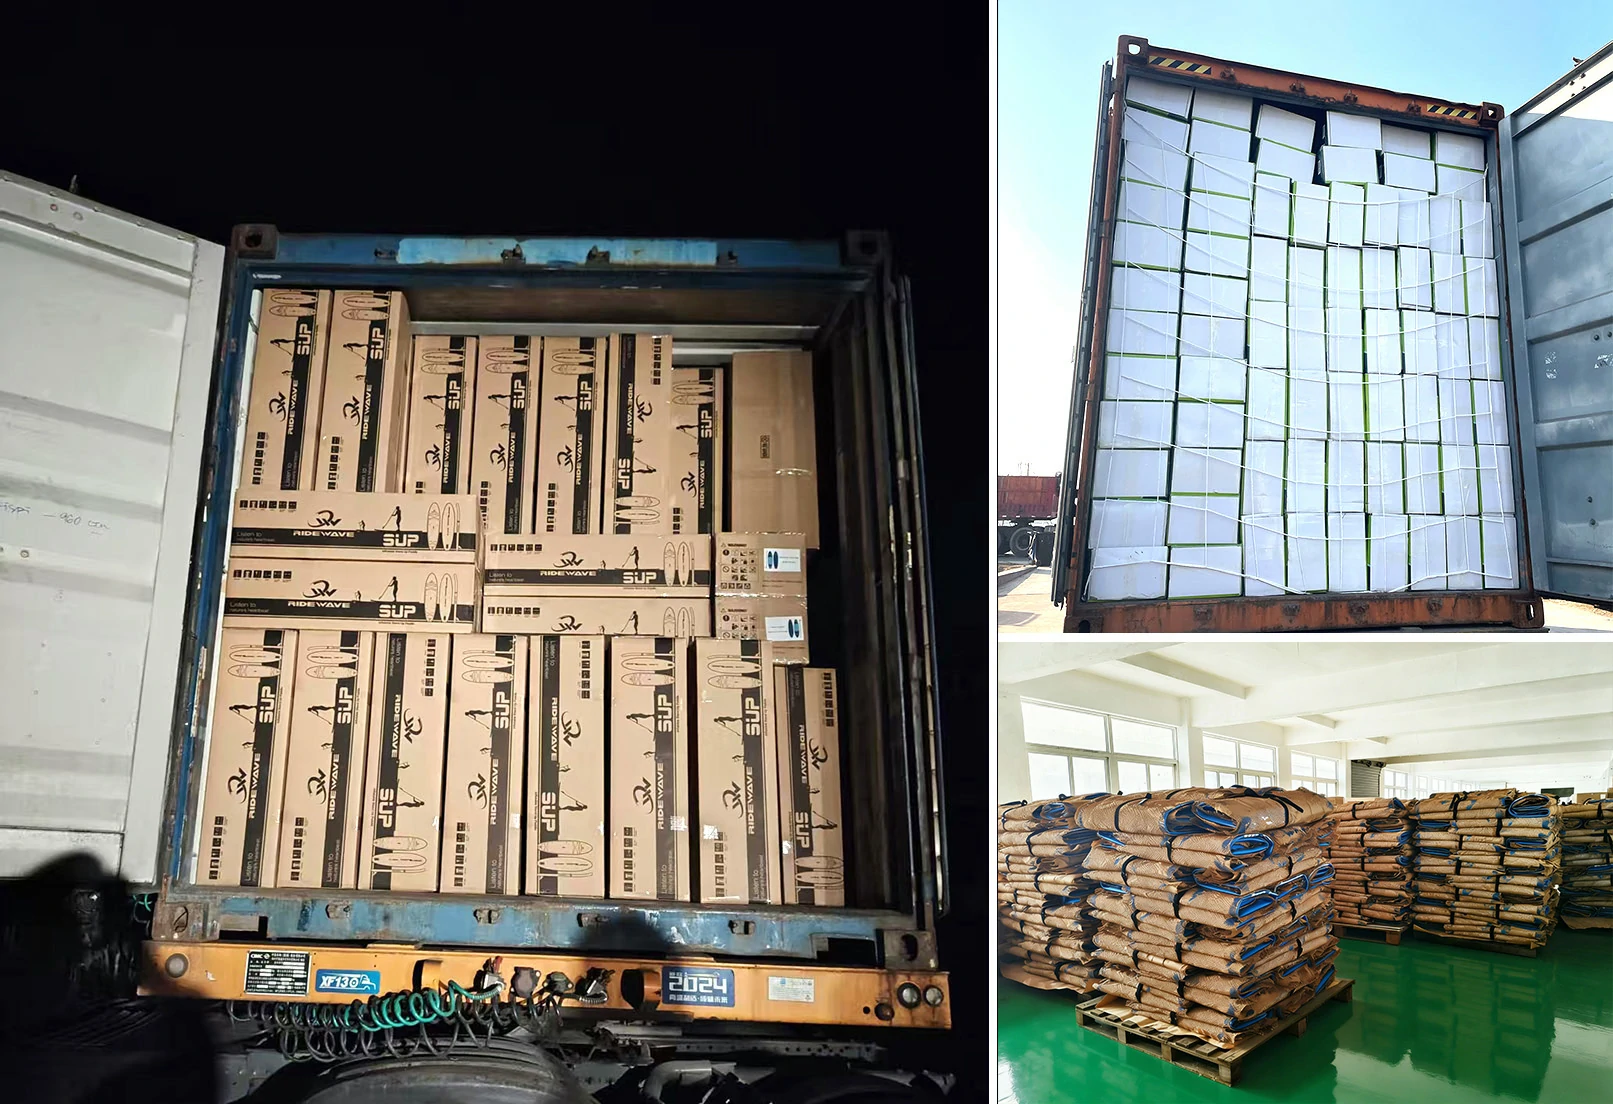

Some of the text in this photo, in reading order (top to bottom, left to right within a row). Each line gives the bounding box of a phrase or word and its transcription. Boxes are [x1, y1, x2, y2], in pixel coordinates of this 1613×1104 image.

[296, 323, 311, 354] SUP
[369, 327, 384, 359] SUP
[448, 380, 460, 409] SUP
[512, 379, 525, 408] SUP
[579, 380, 592, 410] SUP
[700, 409, 712, 438] SUP
[617, 458, 630, 489] SUP
[382, 533, 419, 547] SUP
[622, 571, 656, 584] SUP
[378, 604, 416, 618] SUP
[258, 685, 275, 723] SUP
[337, 686, 352, 723] SUP
[495, 691, 509, 728] SUP
[657, 694, 672, 731] SUP
[744, 697, 761, 735] SUP
[377, 788, 393, 827] SUP
[540, 791, 555, 831] SUP
[794, 811, 810, 848] SUP
[244, 860, 252, 881] Listen
[325, 861, 333, 882] Listen
[668, 975, 728, 994] 2024
